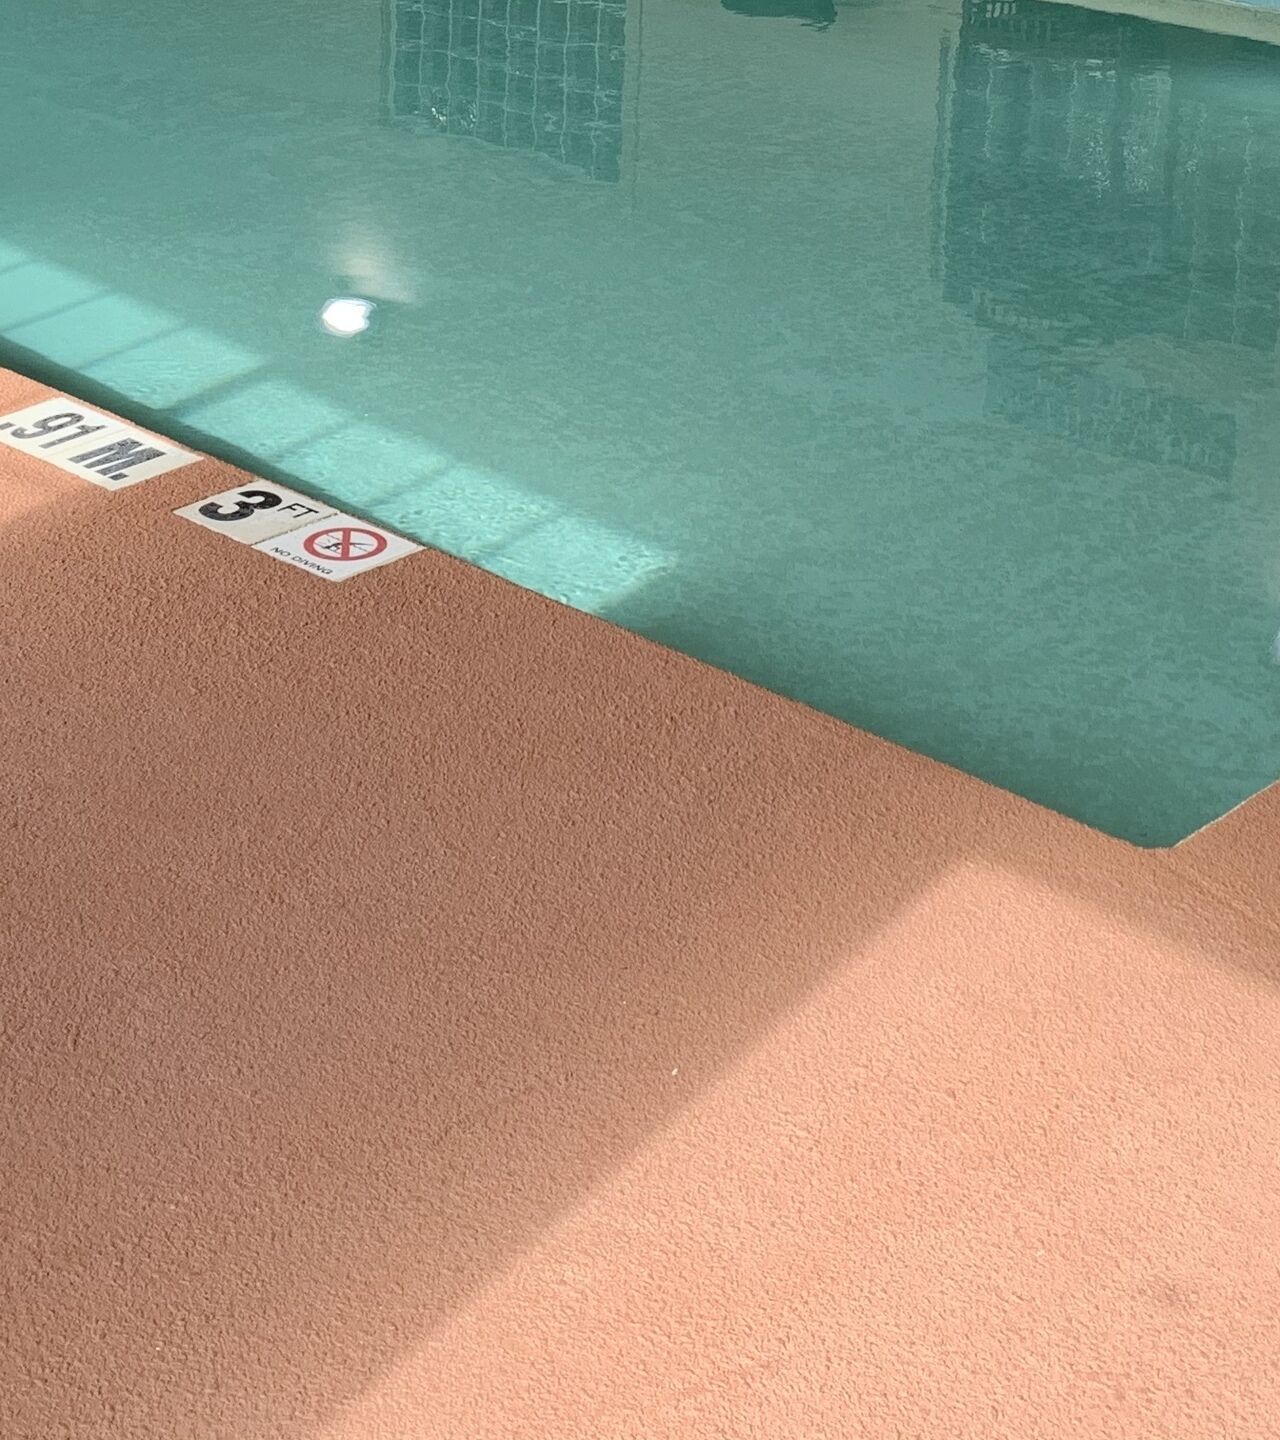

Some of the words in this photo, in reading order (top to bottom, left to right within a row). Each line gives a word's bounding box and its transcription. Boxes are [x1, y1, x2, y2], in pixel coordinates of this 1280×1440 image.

[198, 490, 283, 522] 3
[276, 502, 320, 519] FT
[270, 547, 291, 557] NO
[291, 556, 334, 575] DIVING
